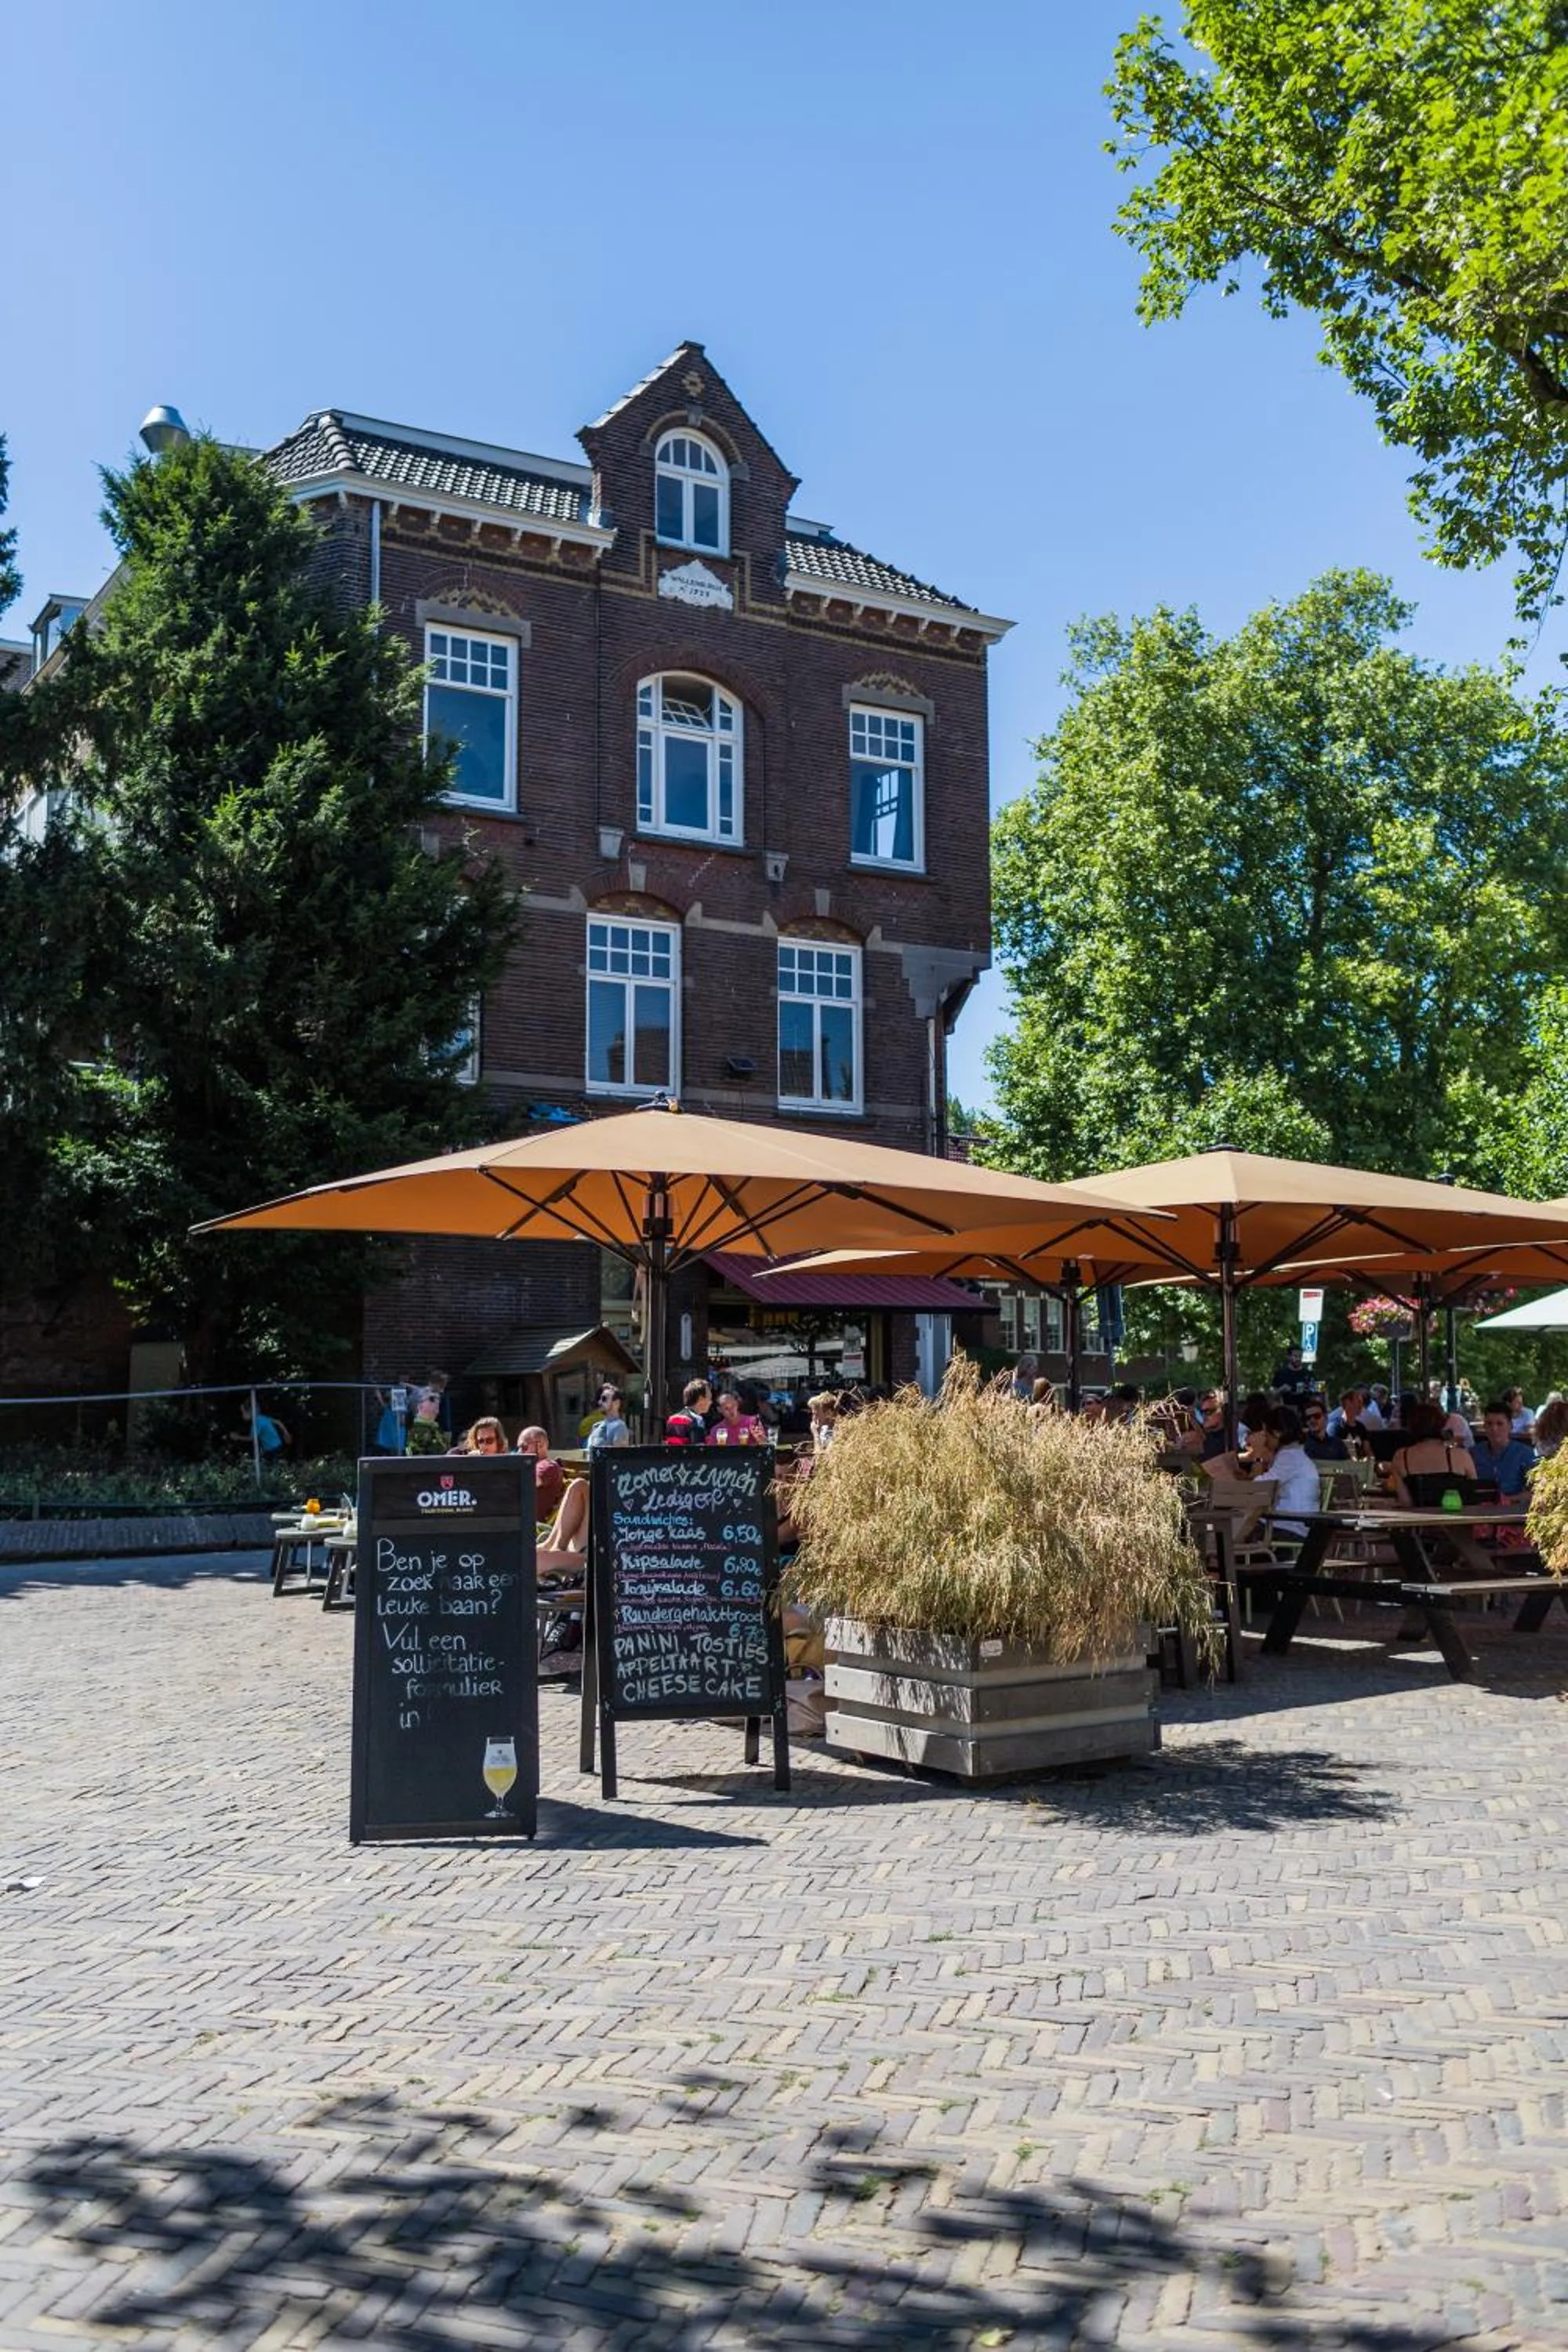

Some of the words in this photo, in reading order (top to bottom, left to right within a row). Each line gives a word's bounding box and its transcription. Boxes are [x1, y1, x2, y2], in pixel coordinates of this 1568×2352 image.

[690, 1463, 757, 1497] Lunch
[377, 1537, 421, 1572] Ben
[427, 1550, 448, 1577] je
[459, 1554, 485, 1575] op
[620, 1552, 706, 1573] Kipsalade
[387, 1574, 433, 1592] zoek
[439, 1588, 503, 1615] baan?
[383, 1622, 422, 1650] Vul
[429, 1635, 466, 1650] een
[399, 1702, 420, 1729] in
